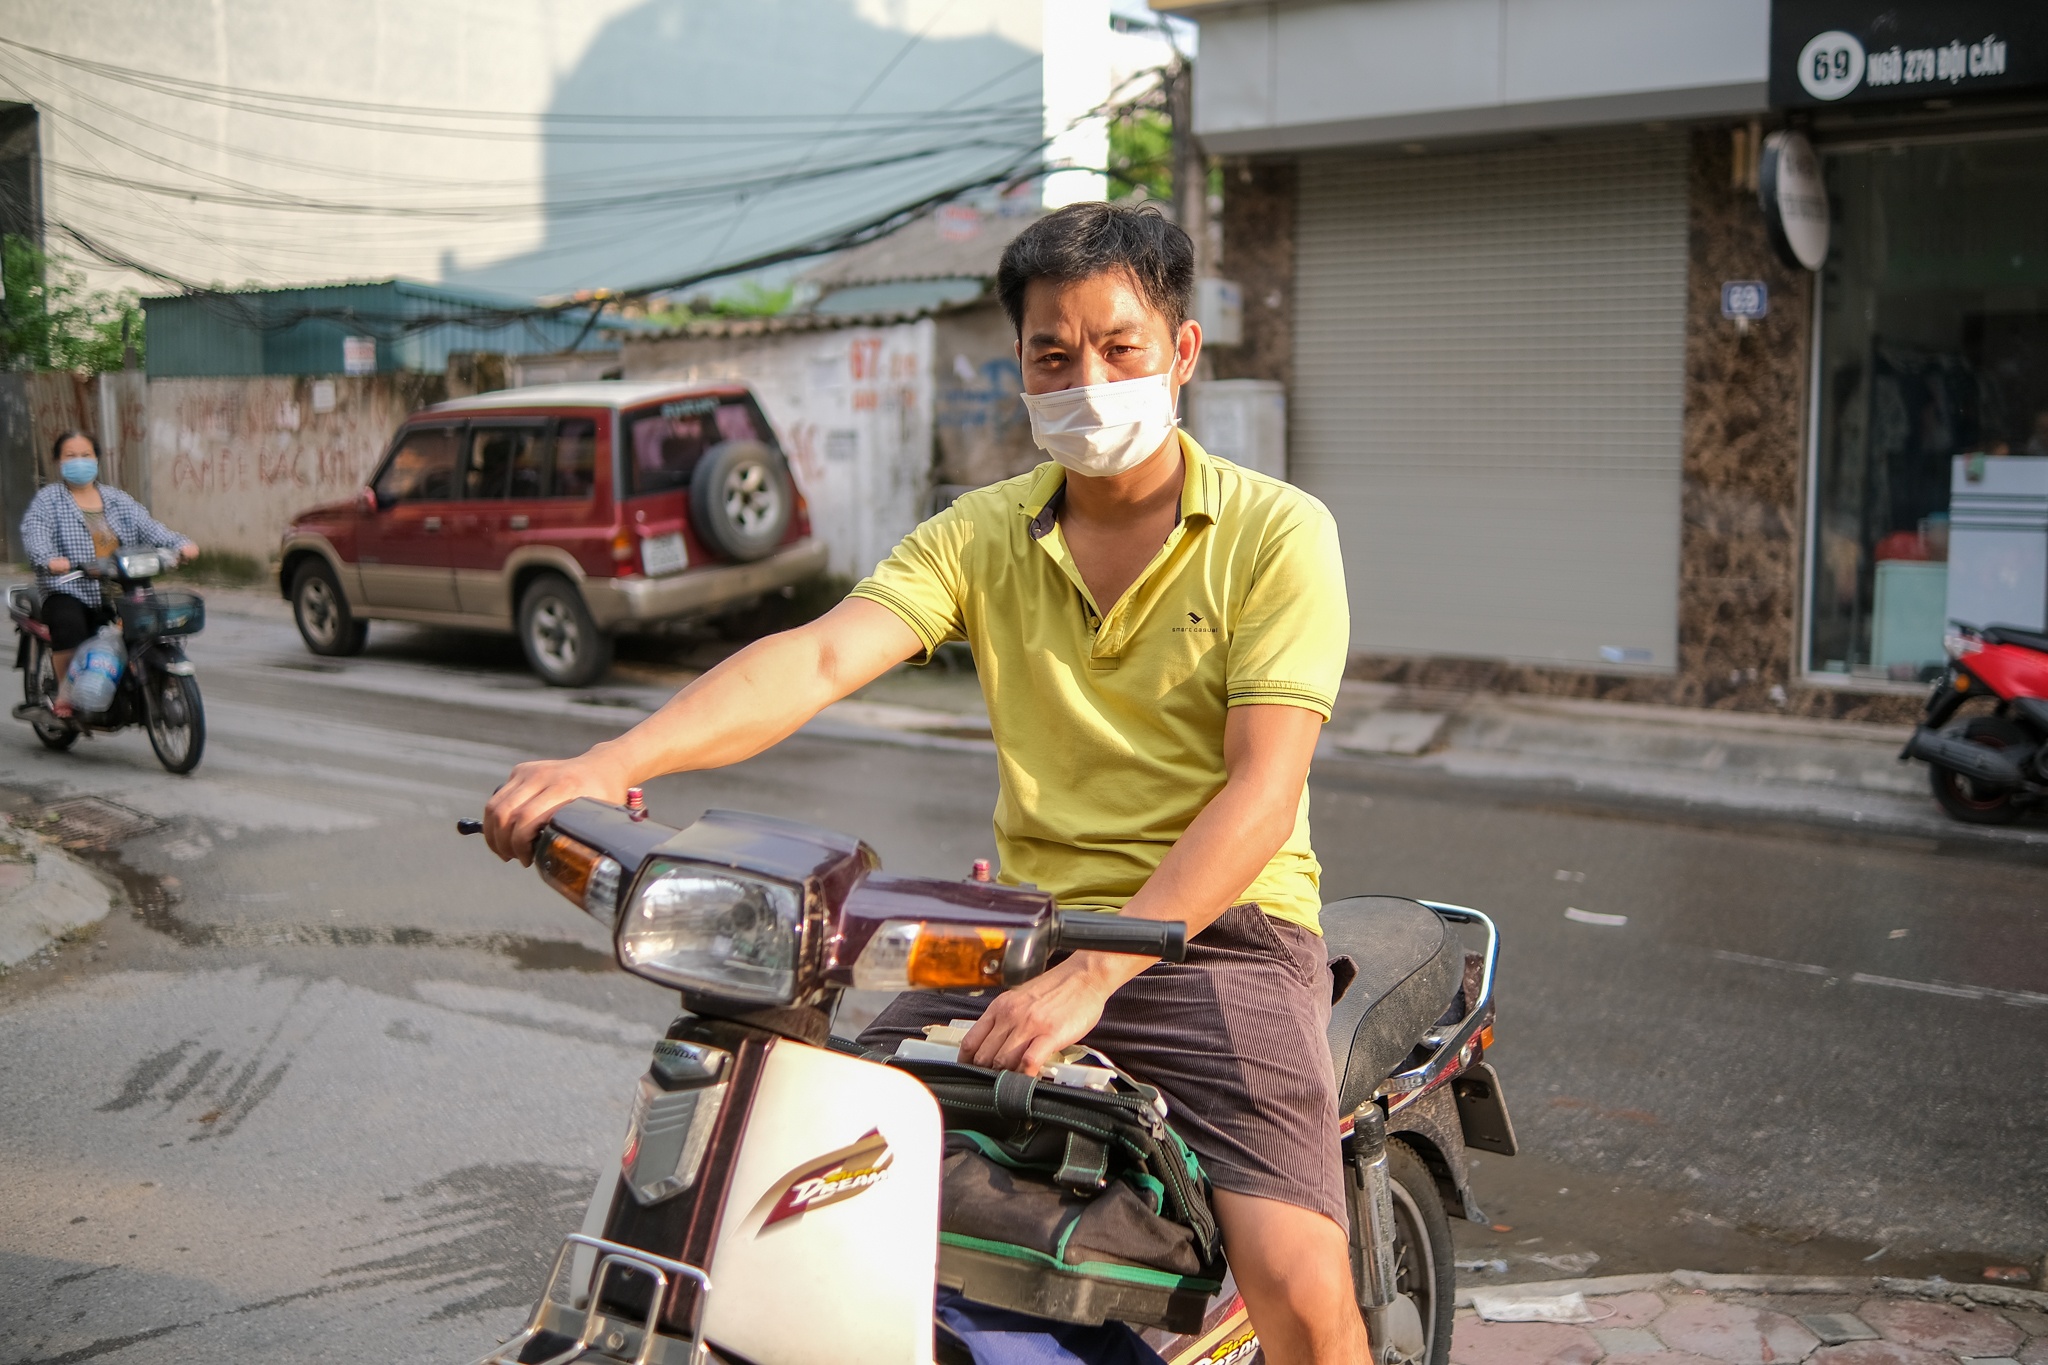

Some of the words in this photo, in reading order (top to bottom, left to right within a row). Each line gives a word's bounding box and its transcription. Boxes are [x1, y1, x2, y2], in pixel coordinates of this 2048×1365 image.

[1813, 49, 1850, 81] 69
[656, 1045, 698, 1061] HONDA
[789, 1167, 889, 1208] DREAM
